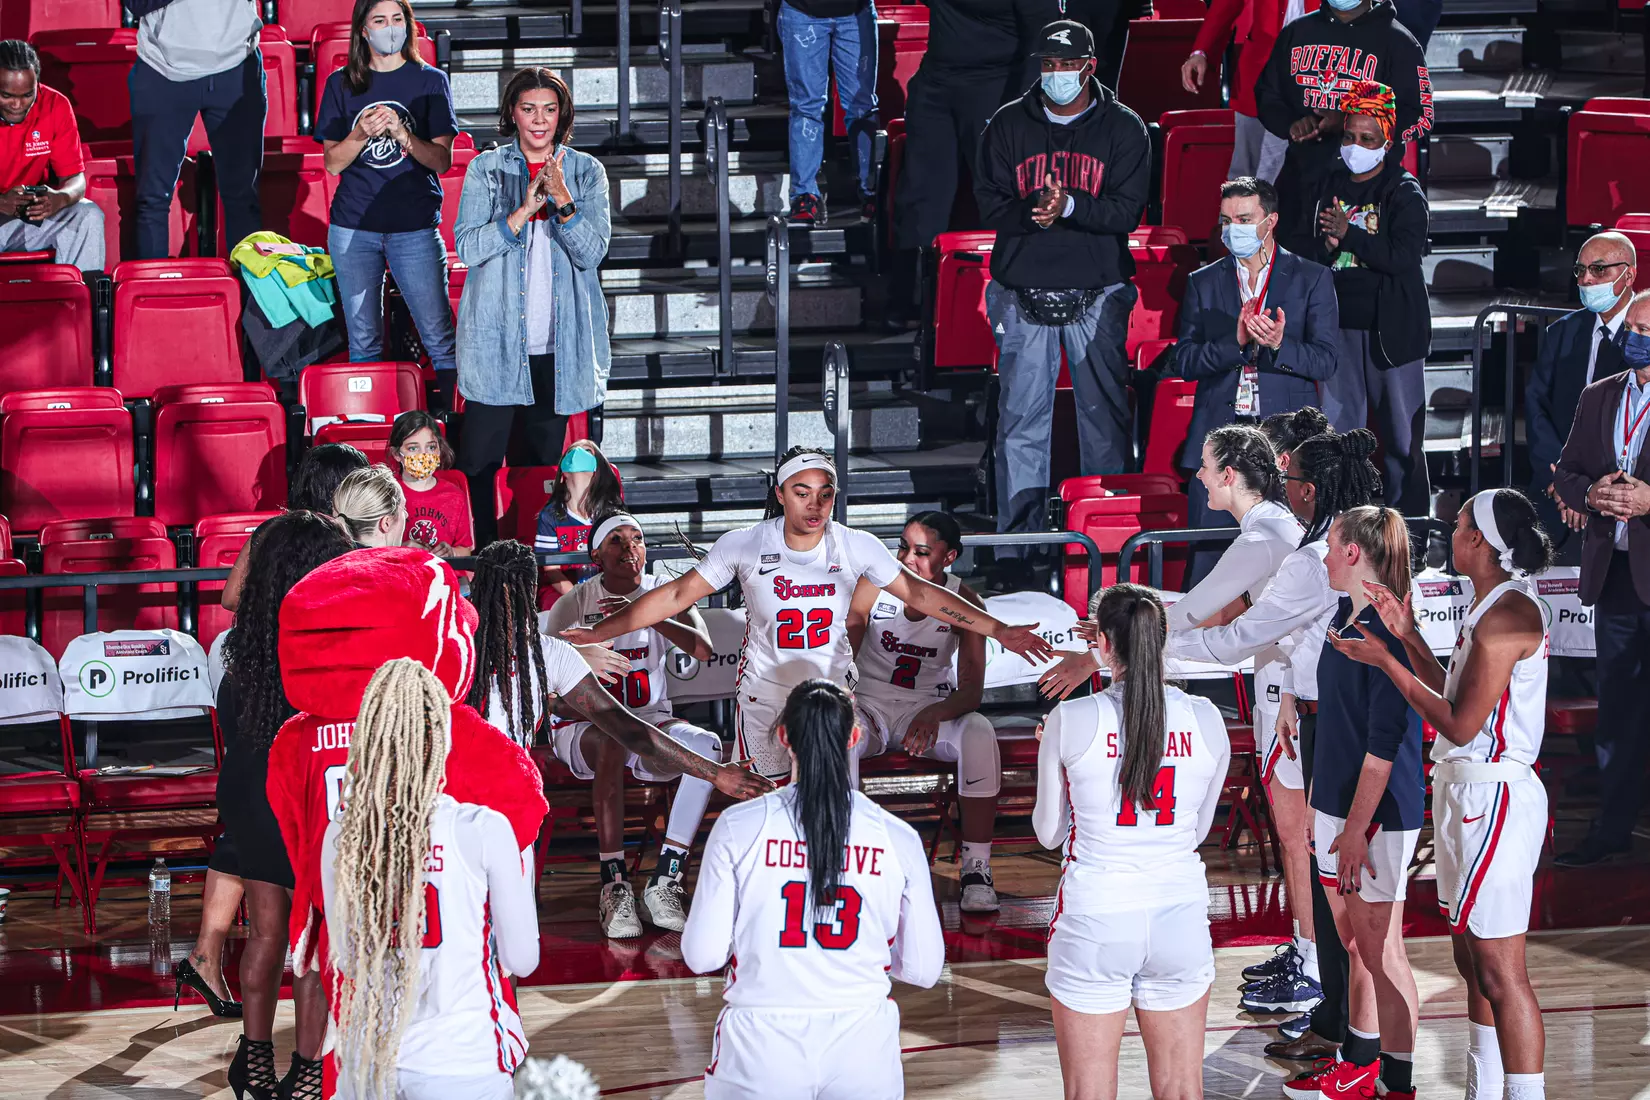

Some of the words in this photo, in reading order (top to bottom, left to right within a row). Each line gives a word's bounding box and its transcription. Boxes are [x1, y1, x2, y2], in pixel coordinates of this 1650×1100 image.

[1290, 44, 1378, 82] BUFFALO
[1016, 153, 1047, 200] RED
[1051, 151, 1105, 199] STORM
[352, 379, 367, 390] 12
[414, 506, 448, 527] JOHN'S
[776, 608, 834, 650] 22
[1559, 608, 1593, 624] Prol
[0, 671, 47, 689] lific1
[890, 655, 921, 690] 2
[312, 721, 357, 752] JOH
[765, 839, 884, 876] COSOVE
[779, 880, 862, 950] 13
